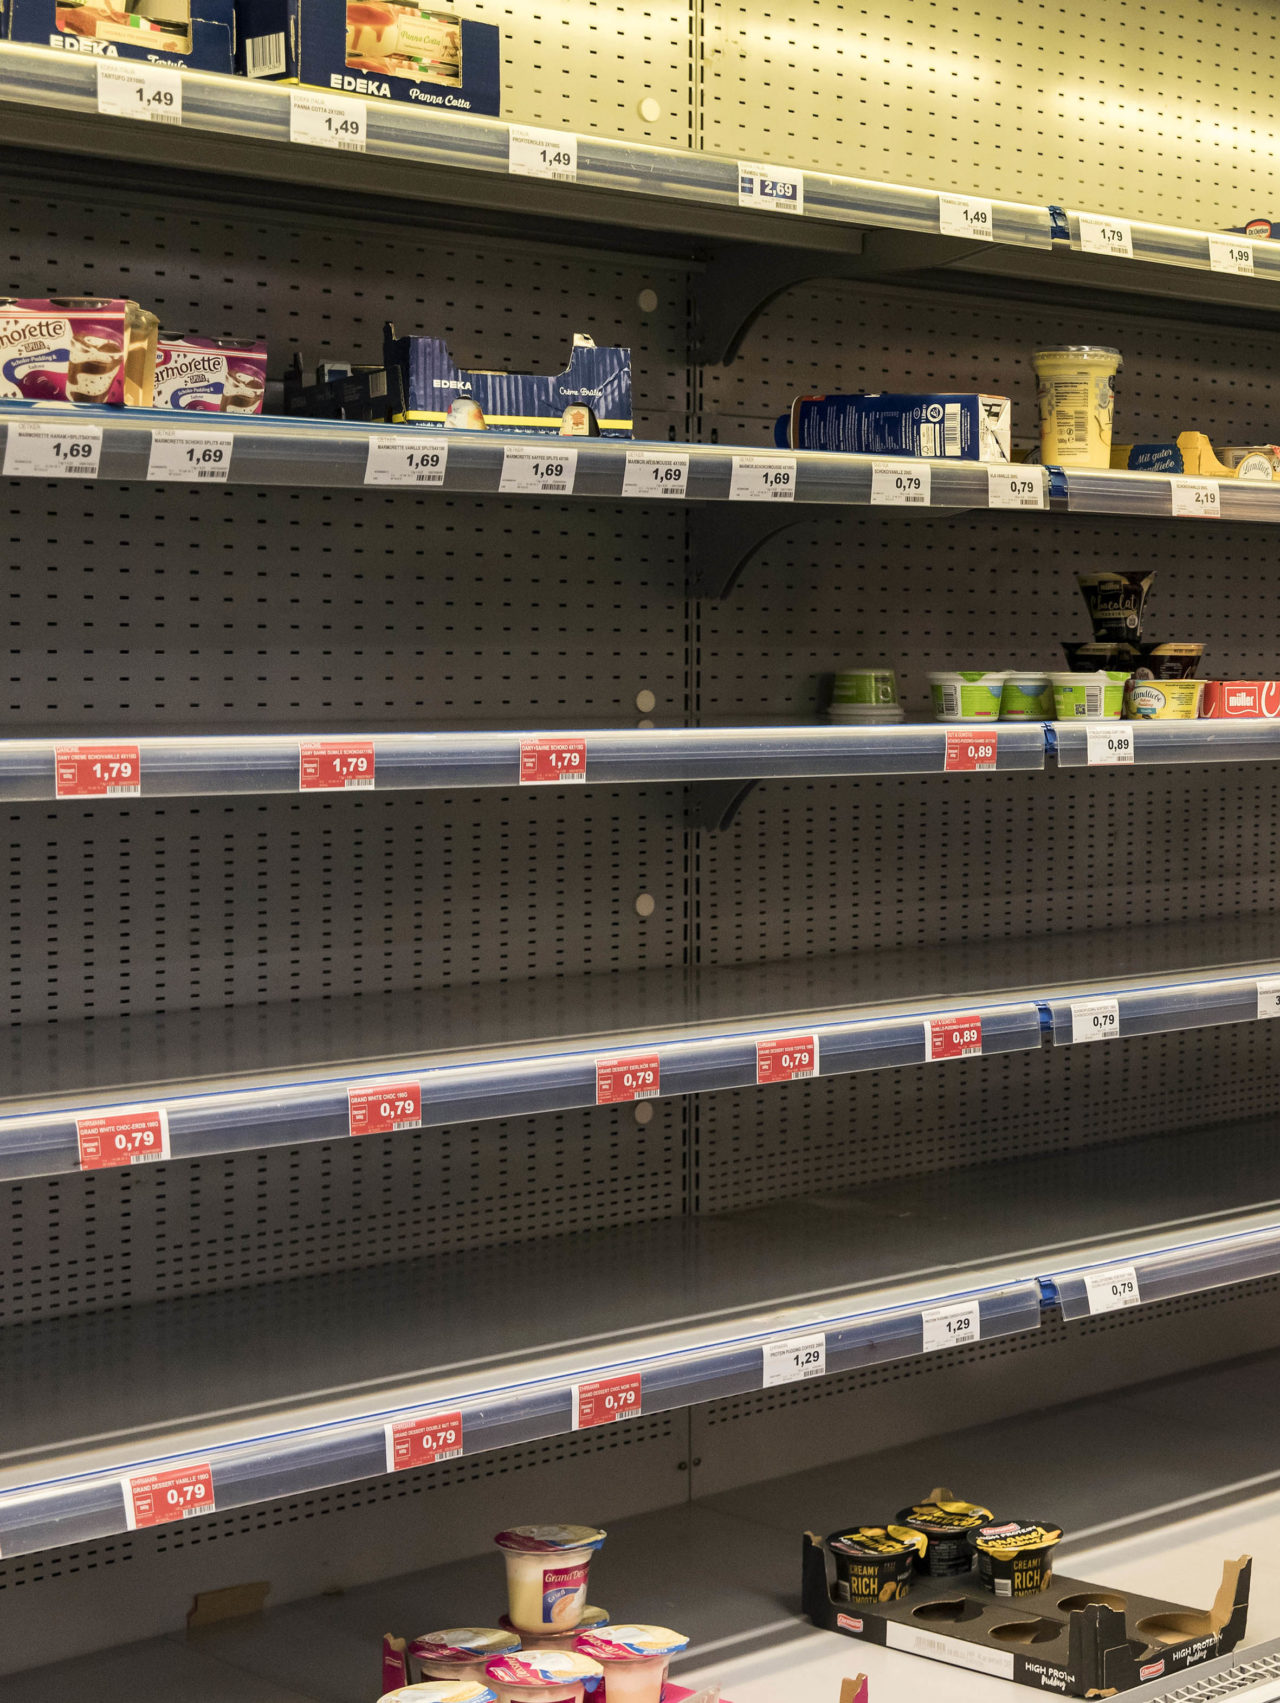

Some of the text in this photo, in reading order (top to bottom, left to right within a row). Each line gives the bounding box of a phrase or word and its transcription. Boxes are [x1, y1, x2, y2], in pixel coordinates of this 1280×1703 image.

[50, 34, 119, 58] EDEKA
[101, 72, 125, 81] TARTUFO
[330, 73, 391, 98] EDEKA
[136, 87, 174, 107] 1,49
[409, 88, 472, 110] Panna Cotta
[294, 103, 310, 111] PANNA
[324, 117, 360, 135] 1,49
[540, 149, 571, 167] 1,49
[764, 181, 793, 197] 2,69
[963, 209, 987, 225] 1,49
[1100, 228, 1123, 244] 1,79
[1229, 249, 1249, 263] 1,99
[433, 379, 472, 390] EDEKA
[559, 386, 578, 397] Crème
[53, 442, 92, 461] 1,69
[186, 448, 223, 466] 1,69
[1136, 449, 1173, 466] Mit guter
[406, 453, 440, 470] 1,69
[532, 463, 563, 479] 1,69
[652, 467, 682, 484] 1,69
[762, 472, 790, 487] 1,69
[896, 477, 921, 492] 0,79
[1010, 481, 1034, 495] 0,79
[1195, 492, 1216, 505] 2,19
[1229, 692, 1254, 707] müller
[967, 745, 992, 760] 0,89
[1108, 738, 1130, 752] 0,89
[332, 757, 368, 775] 1,79
[549, 753, 580, 769] 1,79
[92, 762, 132, 781] 1,79
[1093, 1014, 1115, 1028] 0,79
[952, 1031, 977, 1047] 0,89
[782, 1052, 809, 1068] 0,79
[623, 1070, 654, 1089] 0,79
[380, 1100, 414, 1119] 0,79
[115, 1131, 154, 1151] 0,79
[1111, 1281, 1134, 1297] 0,79
[946, 1317, 970, 1335] 1,29
[793, 1350, 820, 1367] 1,29
[604, 1390, 636, 1410] 0,79
[422, 1429, 456, 1450] 0,79
[132, 1476, 157, 1486] EHRMANN
[133, 1477, 196, 1494] GRAND DESSERT VANILLE
[167, 1483, 206, 1505] 0,79
[850, 1564, 879, 1576] CREAMY
[1013, 1557, 1041, 1570] CREAMY
[545, 1571, 572, 1583] Grand
[1014, 1570, 1040, 1589] RICH
[851, 1576, 878, 1595] RICH
[1172, 1645, 1192, 1661] HIGH
[1025, 1661, 1047, 1675] HIGH
